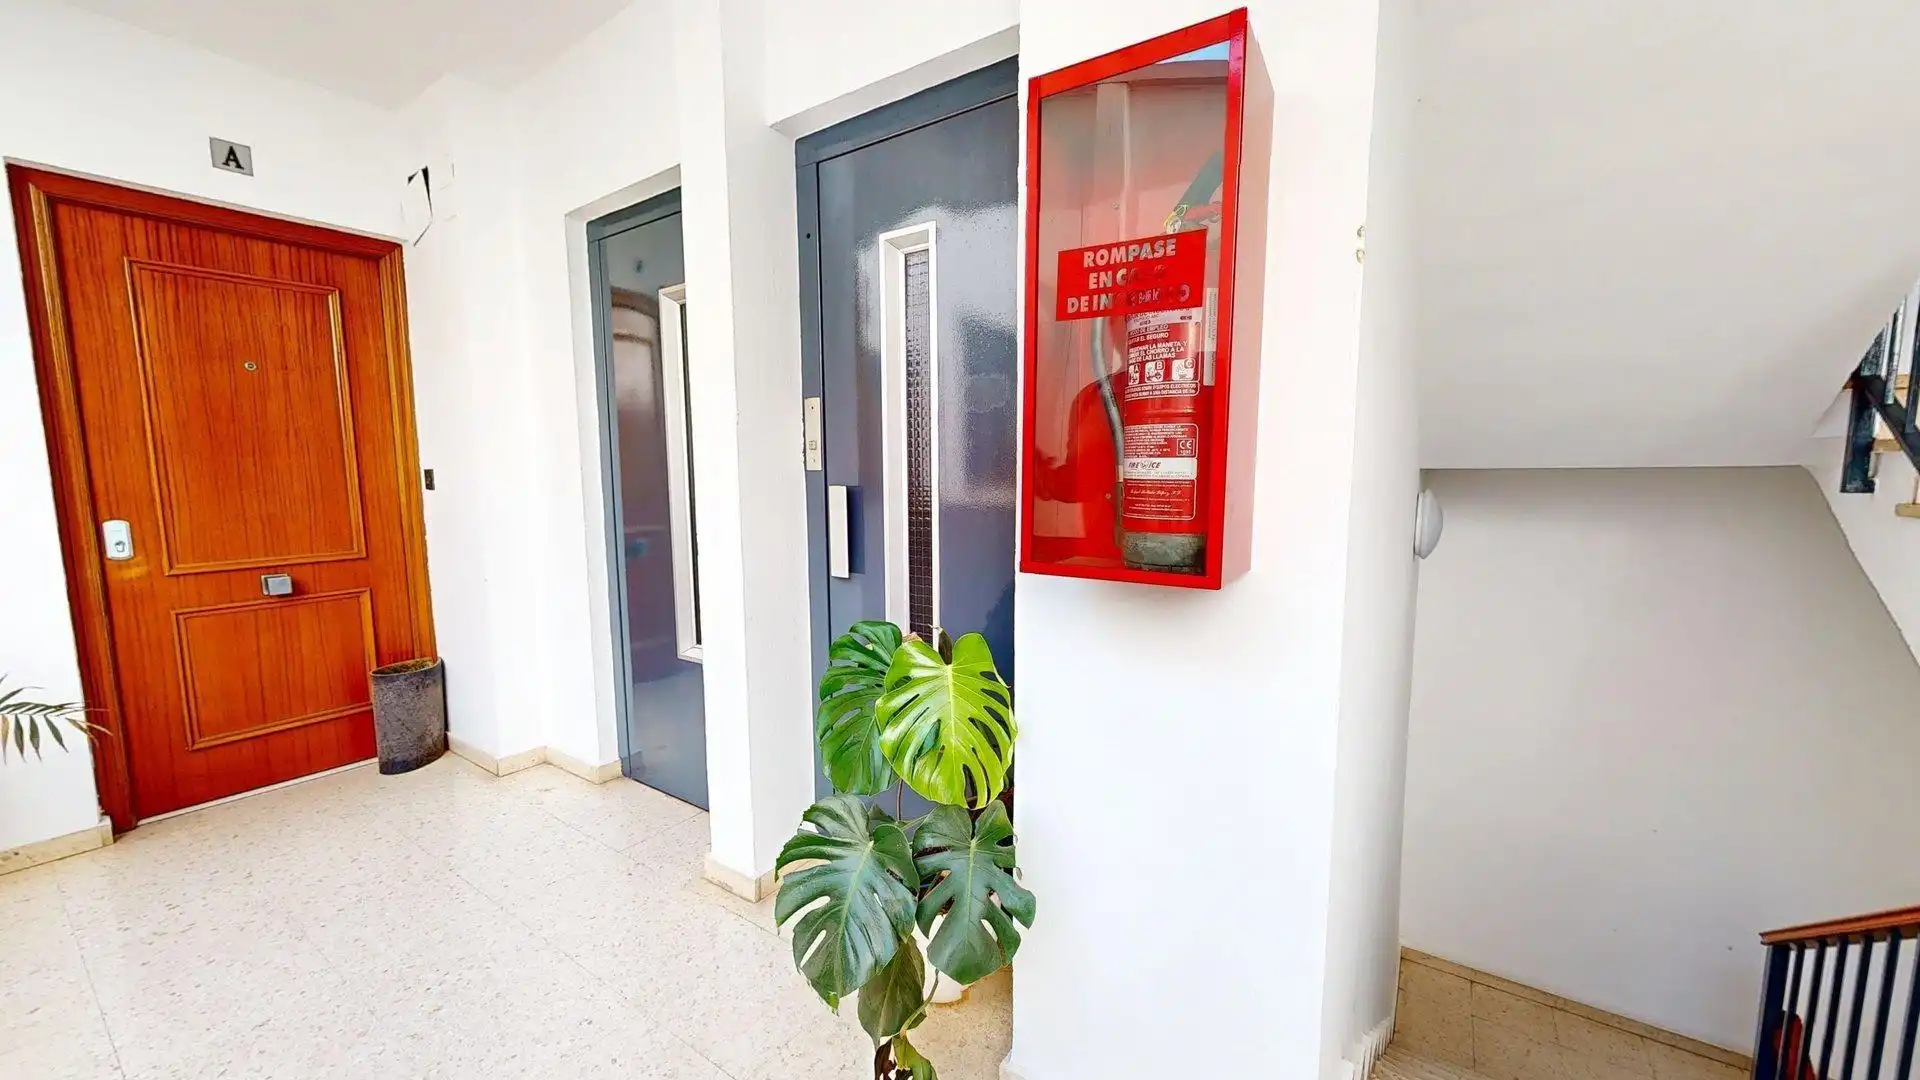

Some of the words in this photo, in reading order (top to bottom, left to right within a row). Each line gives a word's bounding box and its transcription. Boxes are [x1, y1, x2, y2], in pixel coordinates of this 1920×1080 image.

[222, 146, 244, 170] A
[1083, 238, 1177, 268] ROMPASE
[1088, 270, 1112, 290] EN
[1067, 295, 1089, 313] DE
[1146, 332, 1169, 341] SEGURO
[1153, 352, 1176, 360] LLAMAS
[1179, 440, 1192, 449] CE
